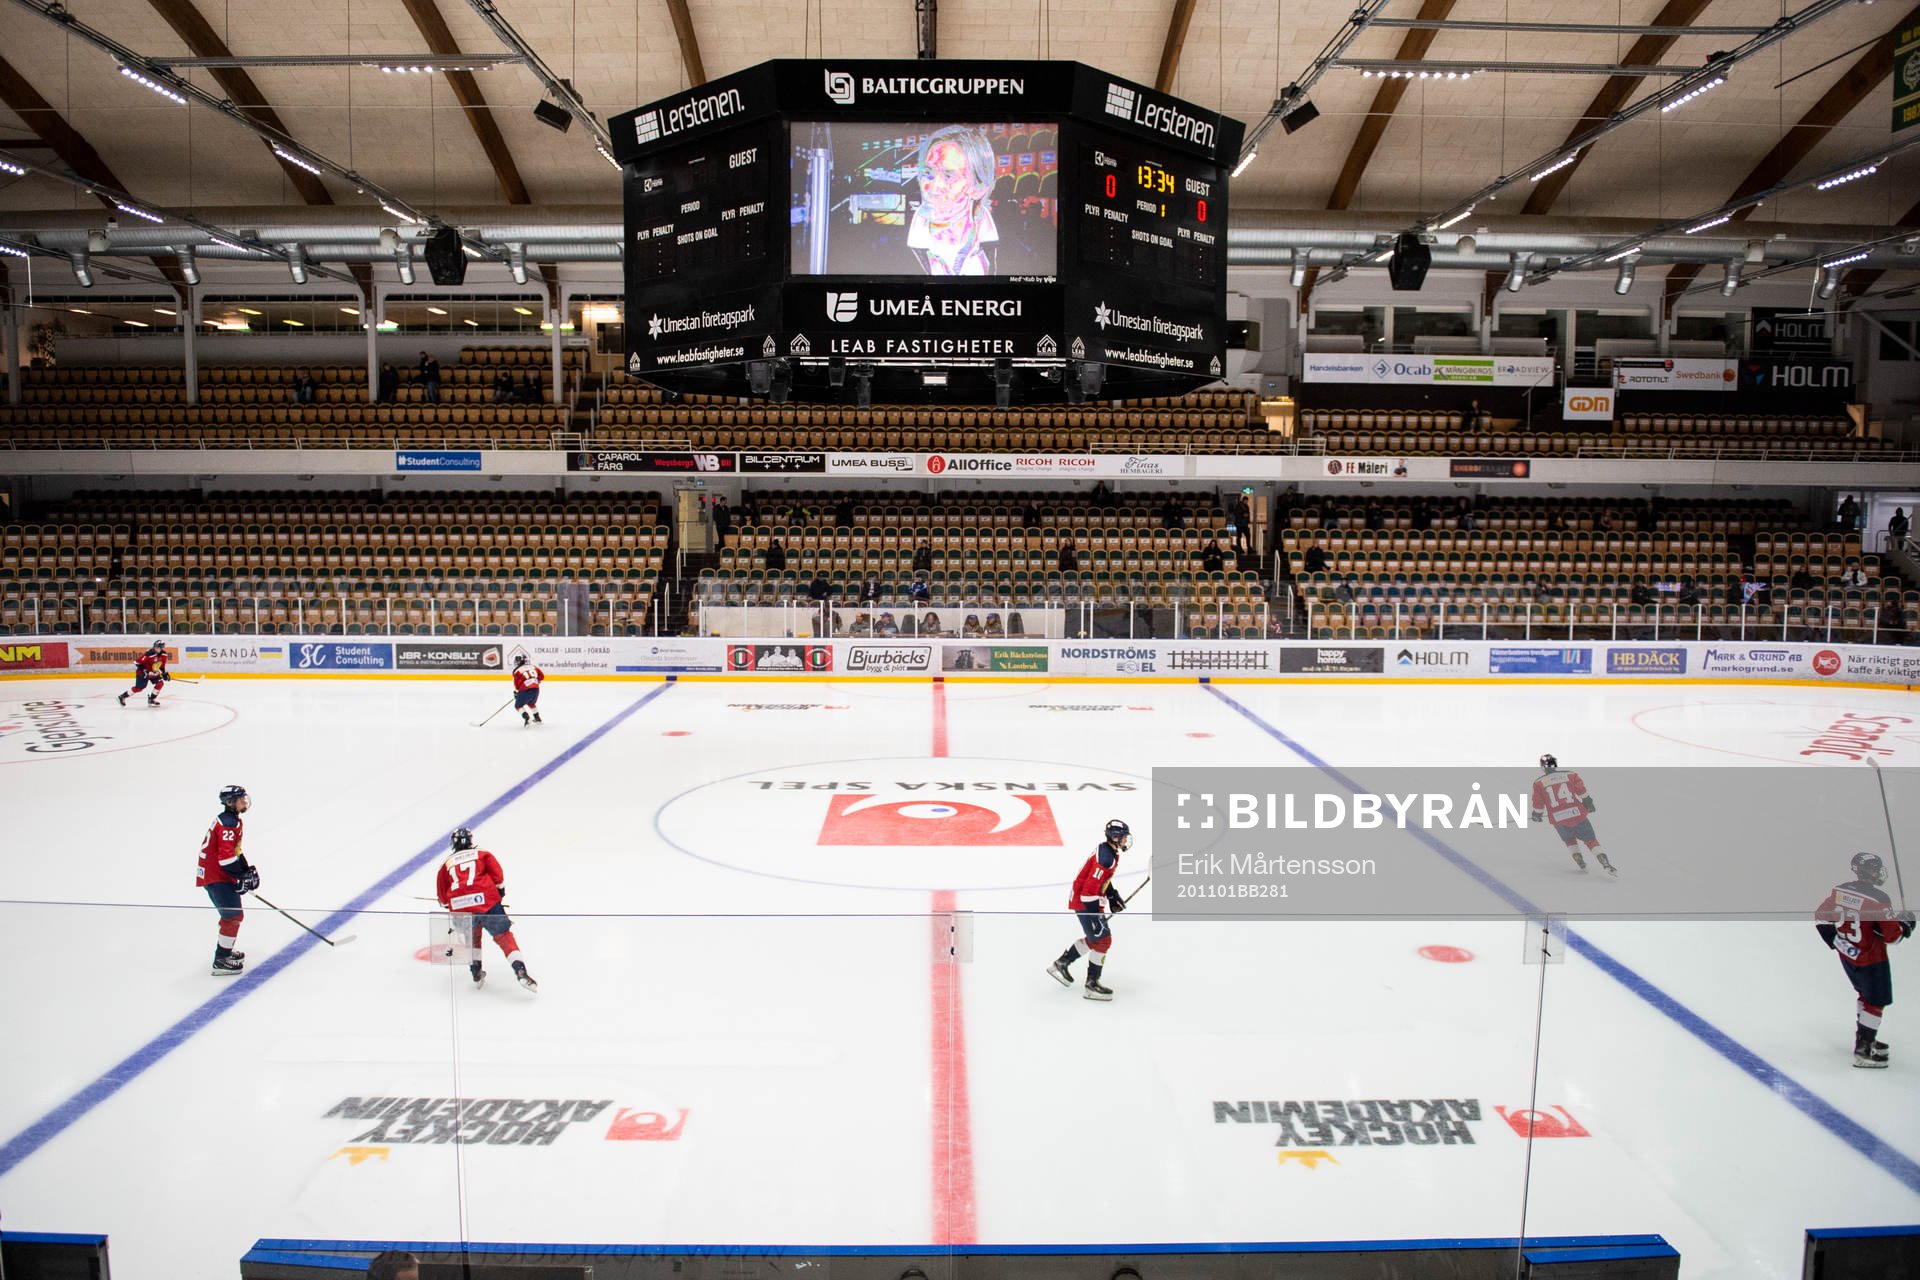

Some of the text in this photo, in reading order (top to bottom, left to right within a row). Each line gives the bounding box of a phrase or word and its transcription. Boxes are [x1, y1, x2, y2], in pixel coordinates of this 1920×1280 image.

[862, 77, 1025, 96] BALTICGRUPPEN
[659, 88, 745, 136] Lerstenen.
[1134, 93, 1216, 149] Lerstenen.
[728, 148, 758, 169] GUEST
[1105, 173, 1117, 198] 0
[1138, 166, 1175, 194] 13:34
[1185, 178, 1211, 197] GUEST
[681, 200, 700, 214] PERIOD
[721, 201, 765, 221] PLYR PENALTY
[1084, 203, 1129, 223] PLYR PENALTY
[1136, 199, 1157, 214] PERIOD
[1197, 199, 1207, 222] 0
[637, 223, 675, 241] PLYR PENALTY
[677, 226, 719, 246] SHOTS ON GOAL
[1131, 229, 1174, 249] SHOTS ON GOAL
[1177, 226, 1216, 245] PLYR PENALTY
[869, 295, 1023, 317] UMEÅ ENERGI
[663, 303, 755, 334] Umestan företagspark
[1112, 311, 1204, 342] Umestan företagspark
[1774, 323, 1824, 338] HOLM
[831, 339, 1015, 353] LEAB FASTIGHETER
[656, 345, 744, 366] www.leabfastigheter.se
[1105, 347, 1194, 369] www.leabfastigheter.se
[1309, 364, 1363, 372] Handelsbanken
[1394, 363, 1432, 376] Ocab
[1675, 370, 1721, 380] Swedbank
[1772, 365, 1849, 387] HOLM
[1569, 396, 1610, 412] GDM
[597, 462, 623, 471] FÄRG
[832, 458, 906, 468] UMEÅ BUSS
[947, 459, 1012, 471] AllOffice
[1016, 458, 1052, 466] RICOH
[1059, 458, 1095, 466] RICOH
[1346, 462, 1387, 474] FE Måleri
[211, 648, 258, 658] SANDÅ
[335, 647, 371, 655] Student
[588, 646, 611, 654] FÖRRÅD
[994, 650, 1008, 659] Erik
[1061, 646, 1157, 659] NORDSTRÖMS
[1317, 649, 1345, 658] happy
[335, 656, 384, 666] Consulting
[853, 649, 925, 669] Bjurbäcks
[1317, 656, 1347, 664] homes
[1415, 651, 1469, 665] HOLM
[1613, 652, 1681, 666] HB DÄCK
[1789, 654, 1802, 662] AB
[1848, 655, 1866, 663] När
[1869, 656, 1900, 667] riktigt
[1142, 663, 1156, 672] EL
[1711, 665, 1794, 673] markogrund.se
[1847, 666, 1872, 674] kaffe
[1875, 667, 1886, 675] är
[748, 780, 1137, 791] SVENSKA SPEL
[1545, 782, 1574, 808] 14
[222, 830, 234, 840] 22
[449, 860, 476, 892] 17
[321, 1097, 613, 1122] AKADEMIN
[1212, 1099, 1482, 1123] AKADEMIN
[349, 1120, 571, 1146] HOCKEY
[1275, 1120, 1476, 1147] HOCKEY
